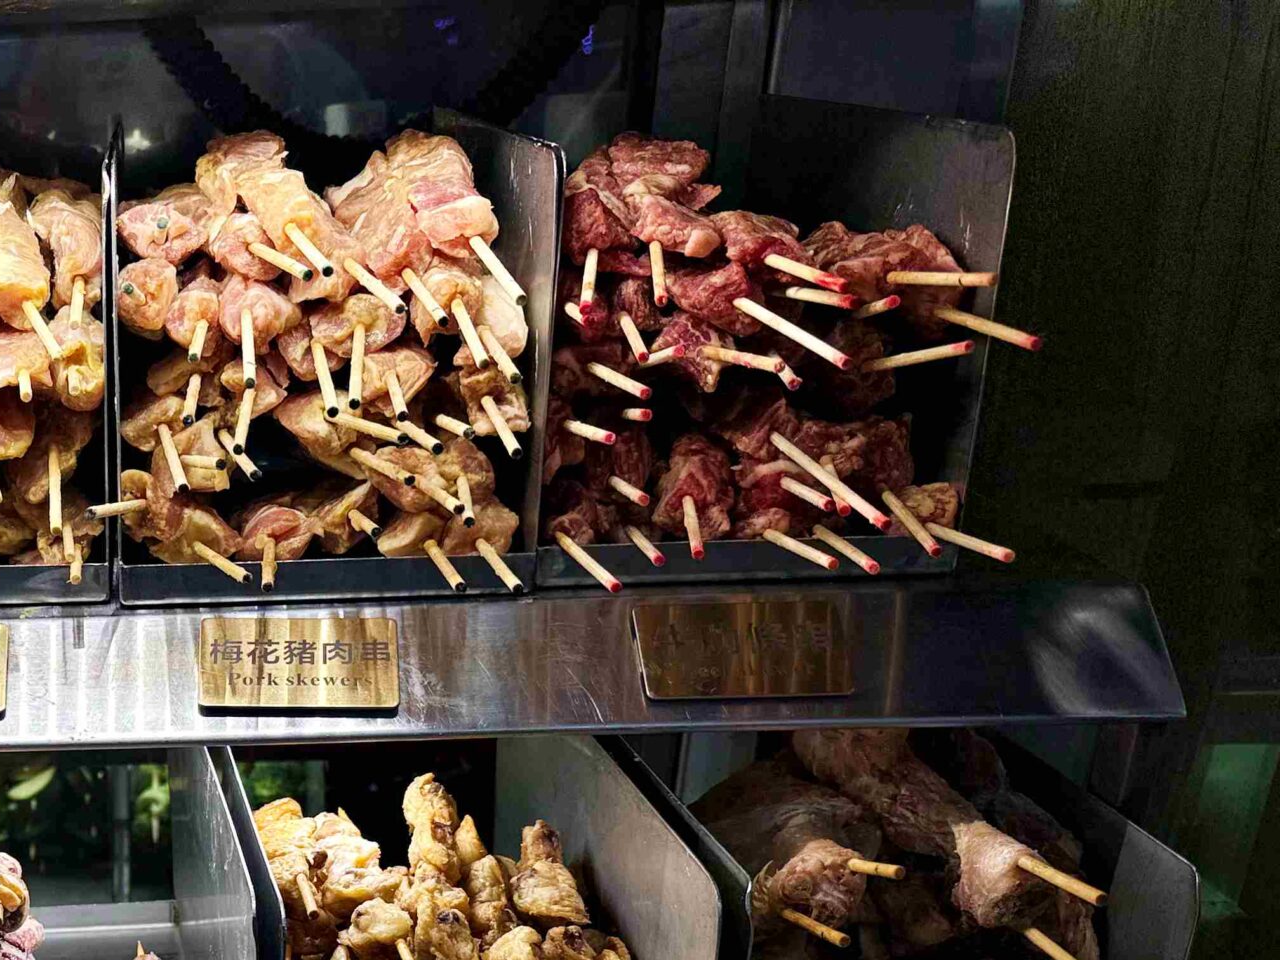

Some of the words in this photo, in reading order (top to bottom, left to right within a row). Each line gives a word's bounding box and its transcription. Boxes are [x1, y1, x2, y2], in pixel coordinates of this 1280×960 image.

[209, 638, 391, 666] 梅花豬肉串
[228, 671, 279, 687] Pork
[285, 672, 374, 687] skewers
